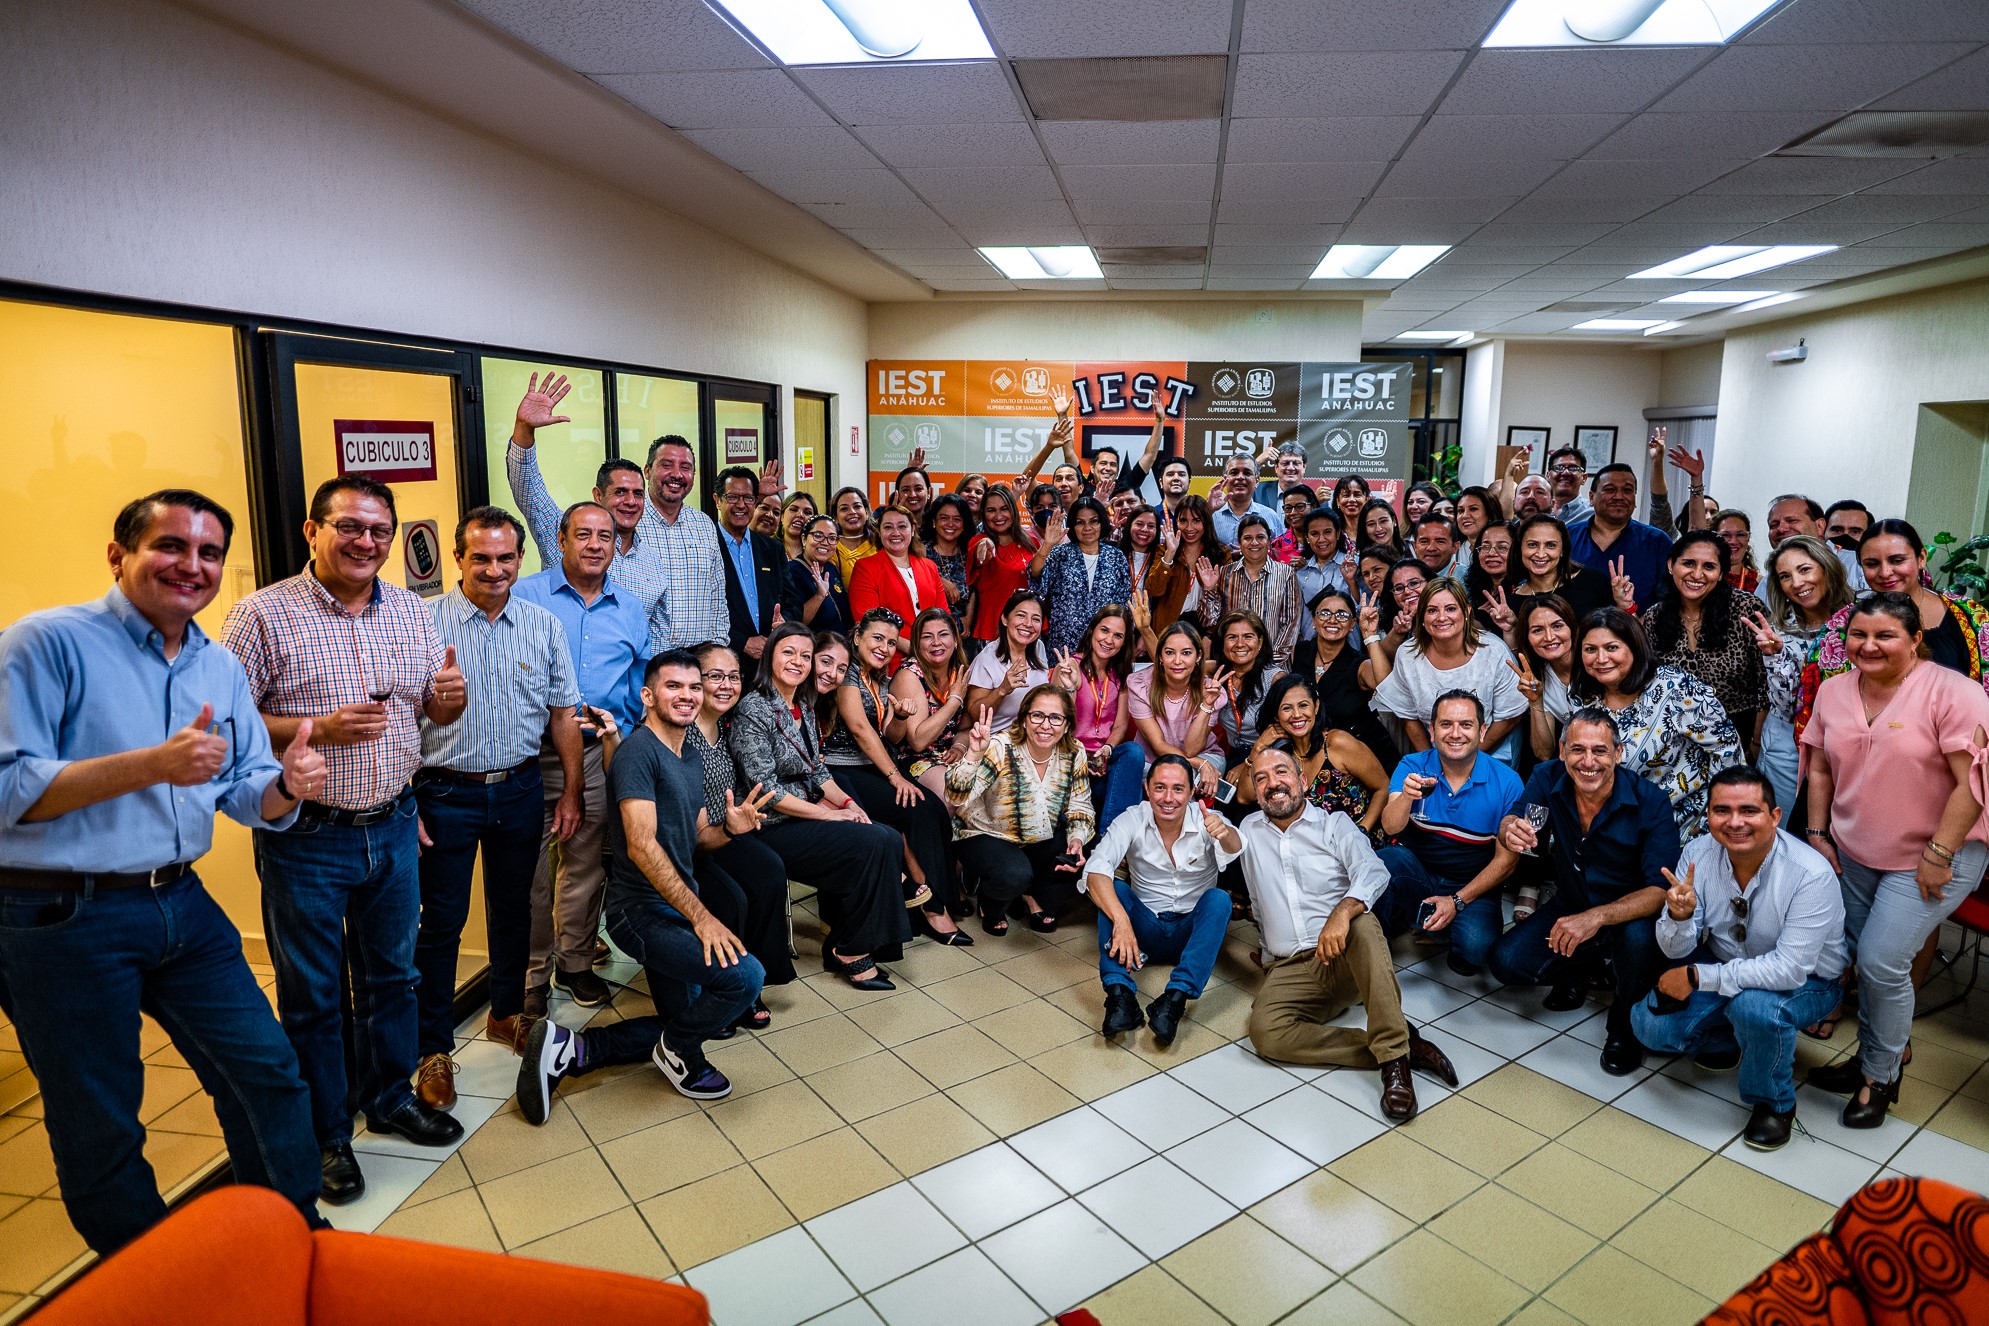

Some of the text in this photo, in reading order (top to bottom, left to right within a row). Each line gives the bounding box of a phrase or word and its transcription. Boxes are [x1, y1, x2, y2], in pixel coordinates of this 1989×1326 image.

[879, 370, 946, 395] IEST
[1073, 372, 1196, 417] IEST
[1322, 372, 1396, 399] IEST
[880, 395, 946, 406] ANÁHUAC
[1322, 399, 1394, 410] ANÁHUAC
[346, 440, 429, 463] CUBICULO 3
[728, 440, 752, 453] CUBICULO
[985, 428, 1051, 453] IEST
[1204, 430, 1276, 456] IEST
[416, 580, 443, 592] VIBRADOR
